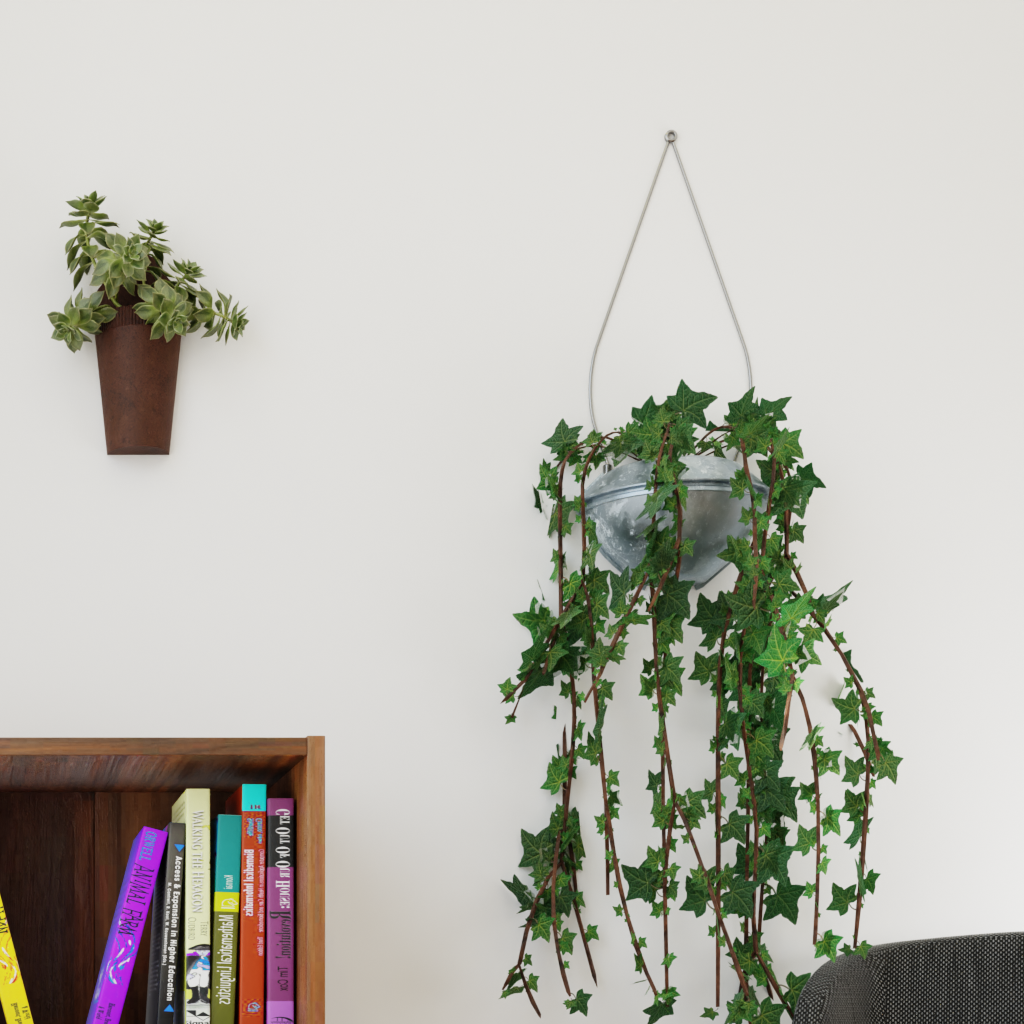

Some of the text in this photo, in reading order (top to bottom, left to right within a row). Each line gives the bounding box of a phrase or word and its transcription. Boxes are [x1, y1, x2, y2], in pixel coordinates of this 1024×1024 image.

[139, 831, 157, 861] ORWELL
[174, 856, 183, 881] Access
[190, 810, 205, 913] WALKING THE HEXAGON
[126, 863, 155, 906] ANIMAL
[118, 907, 143, 936] FARM
[171, 891, 180, 928] Expansion
[187, 917, 197, 941] CUDBIRD
[200, 921, 209, 937] TERRY
[168, 939, 177, 963] Higher
[167, 965, 176, 1001] Education
